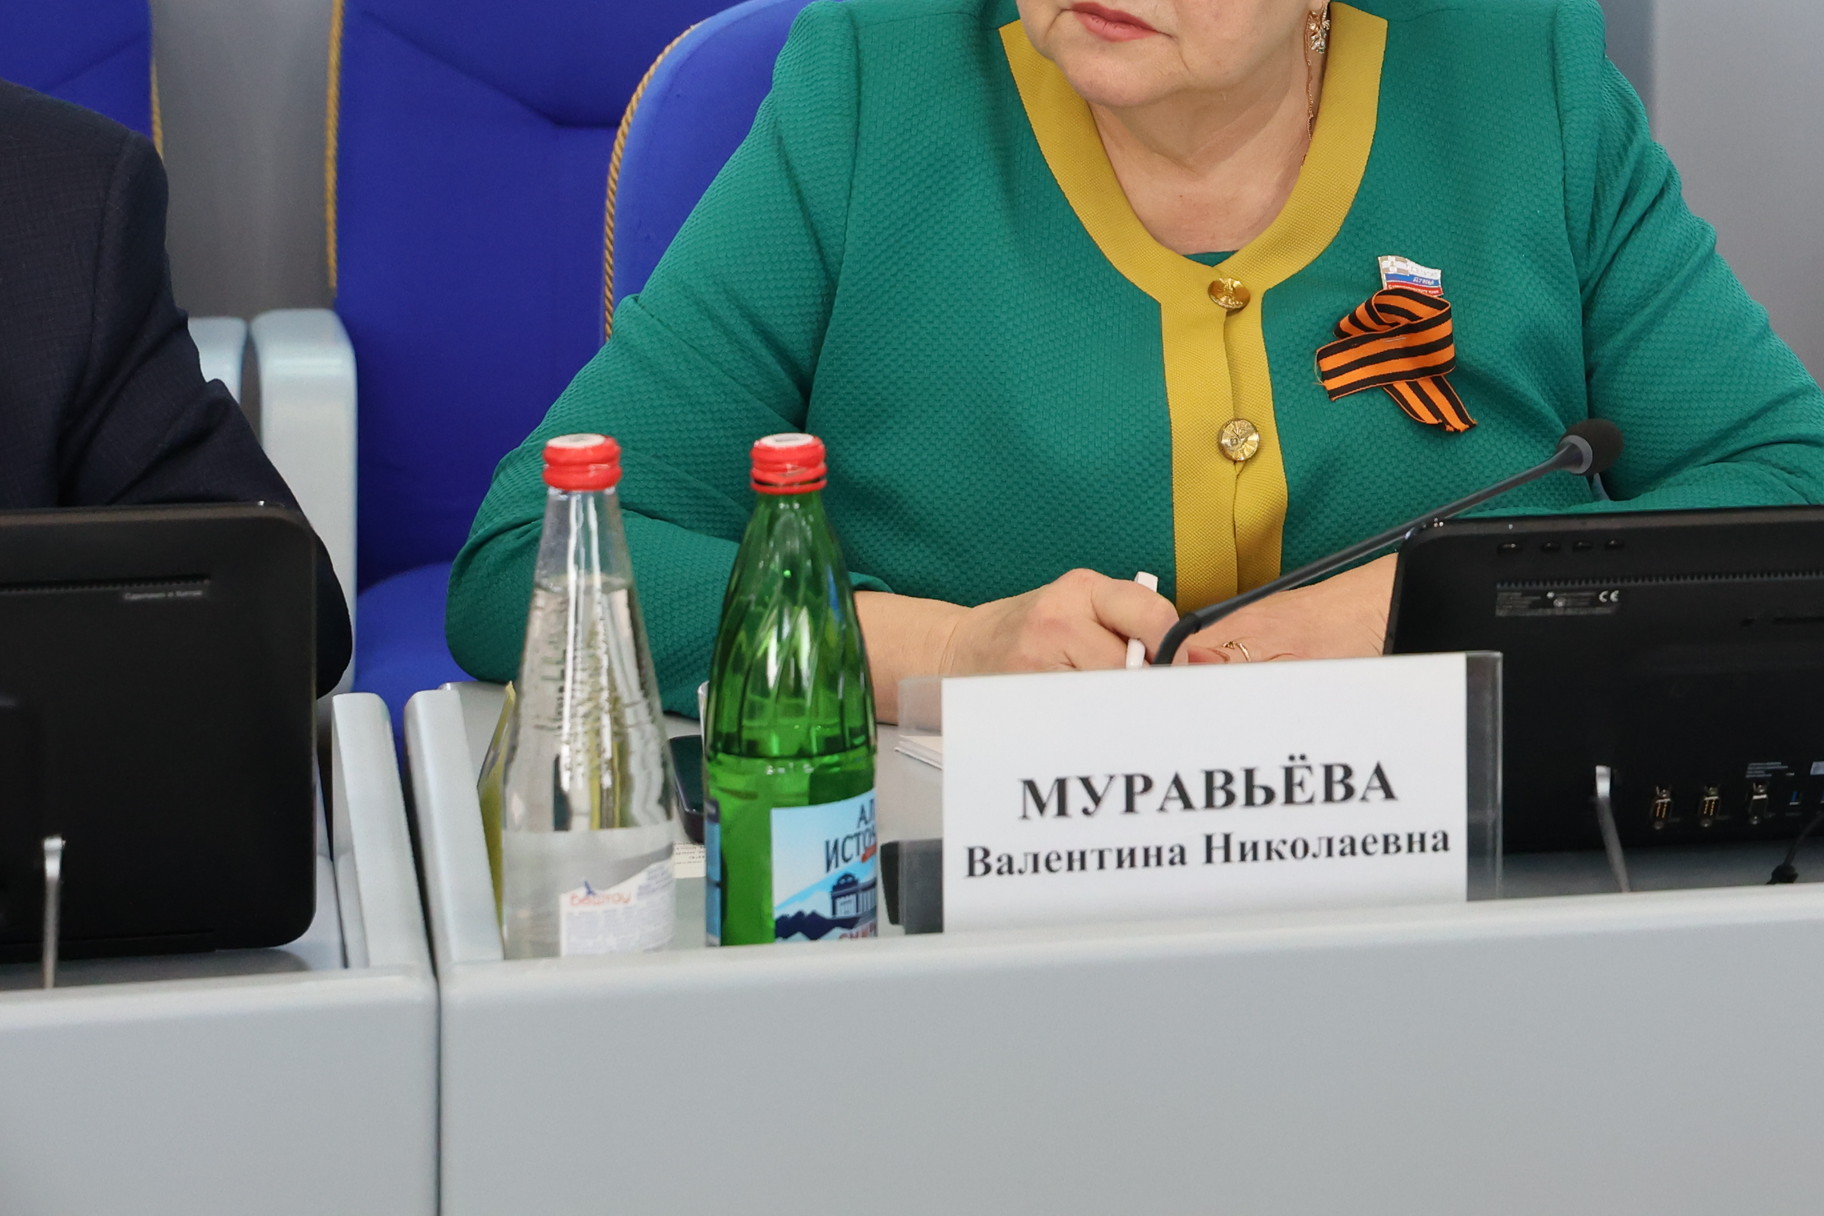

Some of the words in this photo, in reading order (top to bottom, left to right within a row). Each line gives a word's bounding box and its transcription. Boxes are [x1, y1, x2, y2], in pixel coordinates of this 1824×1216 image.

[1019, 754, 1398, 820] МУРАВЬЁВА
[964, 845, 1187, 879] Валентина
[1203, 829, 1450, 866] Николаевна
